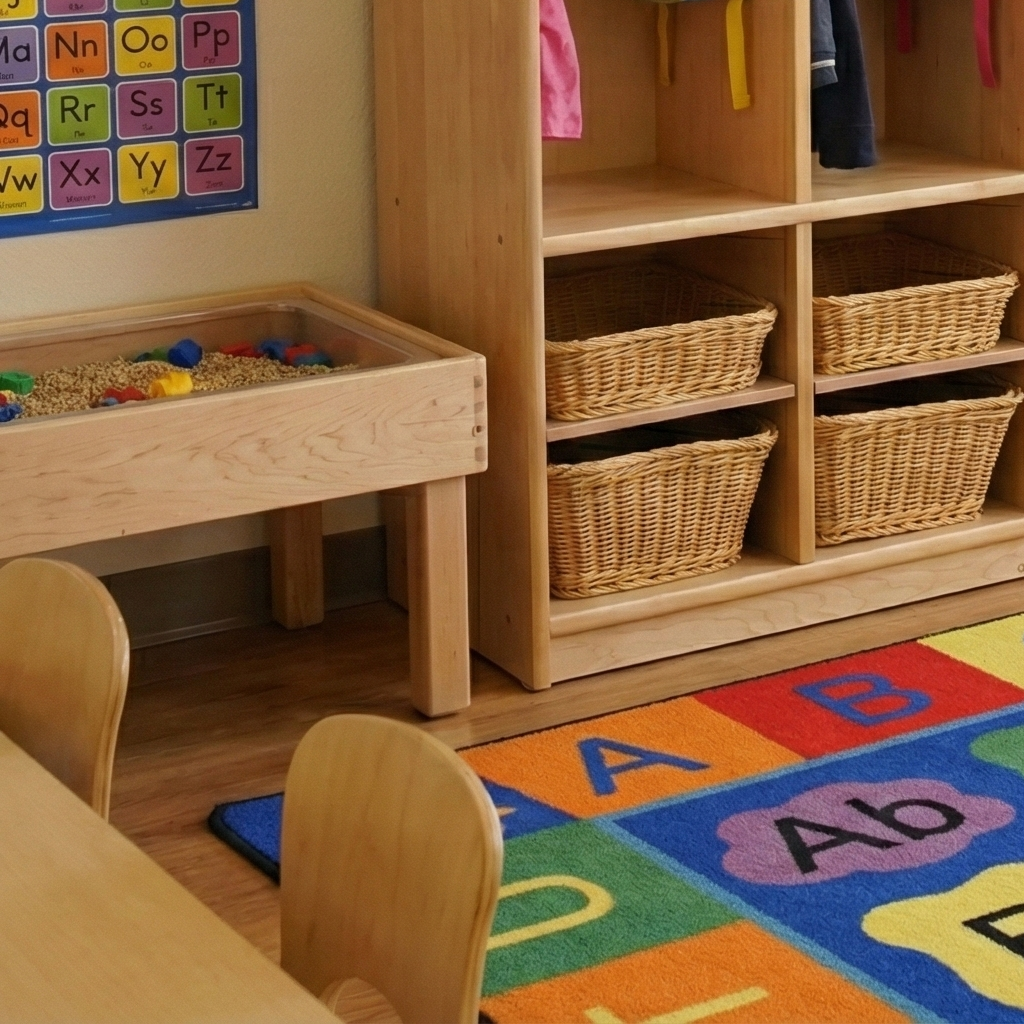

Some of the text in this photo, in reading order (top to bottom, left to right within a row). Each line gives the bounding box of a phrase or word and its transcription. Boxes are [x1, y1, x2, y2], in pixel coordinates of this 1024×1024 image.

[54, 30, 98, 59] Nn
[121, 26, 169, 53] Oo
[193, 21, 230, 57] Pp
[61, 96, 96, 123] Rr
[130, 90, 163, 117] Ss
[197, 83, 228, 110] Tt
[59, 159, 101, 189] Xx
[129, 151, 167, 188] Yy
[196, 146, 232, 173] Zz
[793, 672, 932, 727] B
[577, 737, 711, 797] A
[774, 798, 965, 874] Ab
